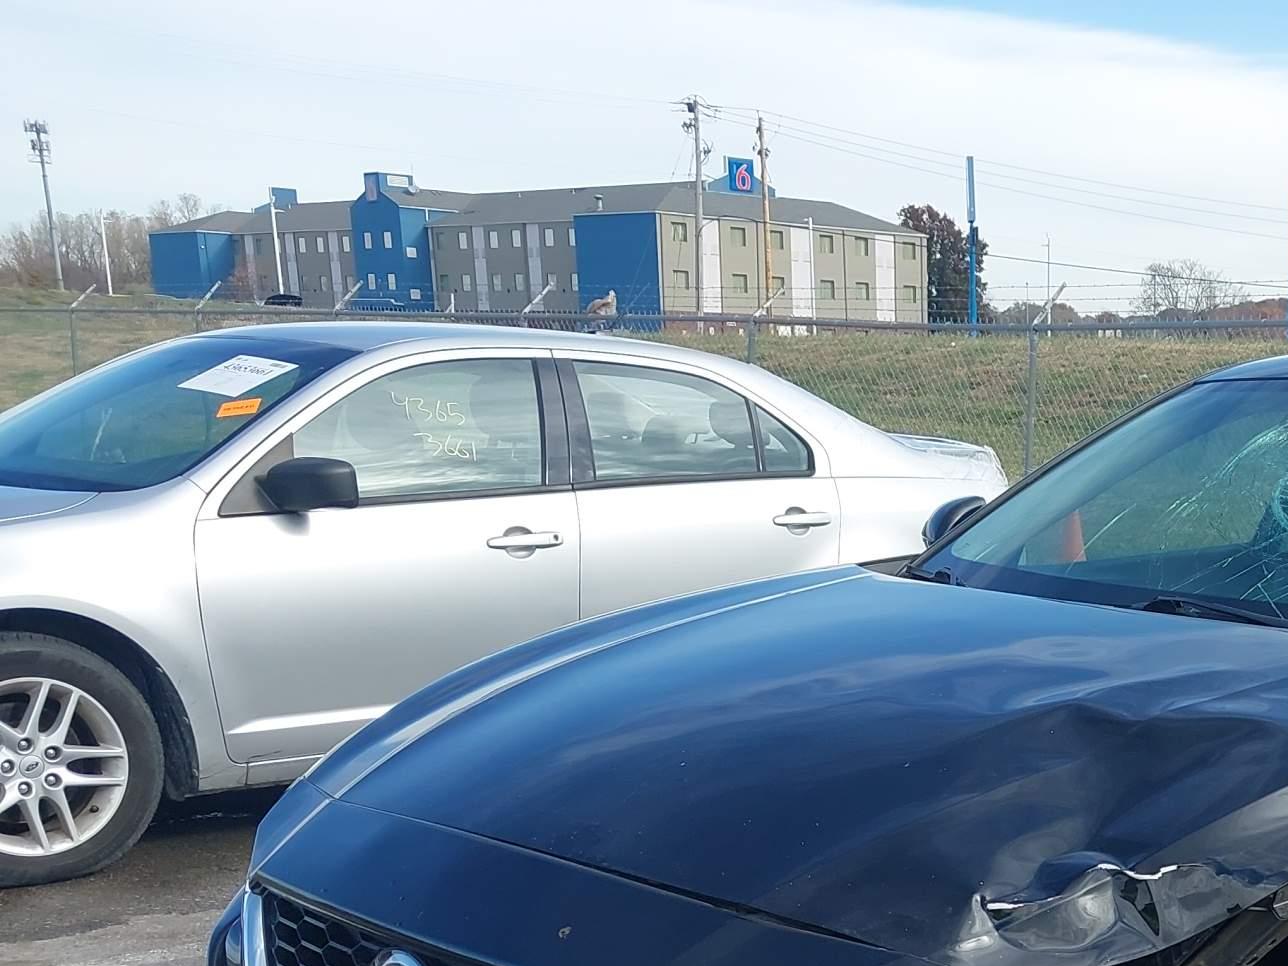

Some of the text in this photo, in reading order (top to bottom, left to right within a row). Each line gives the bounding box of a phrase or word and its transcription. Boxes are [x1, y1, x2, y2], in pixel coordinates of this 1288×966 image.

[736, 163, 751, 190] 6
[391, 391, 465, 426] 4365
[412, 432, 477, 462] 3661
